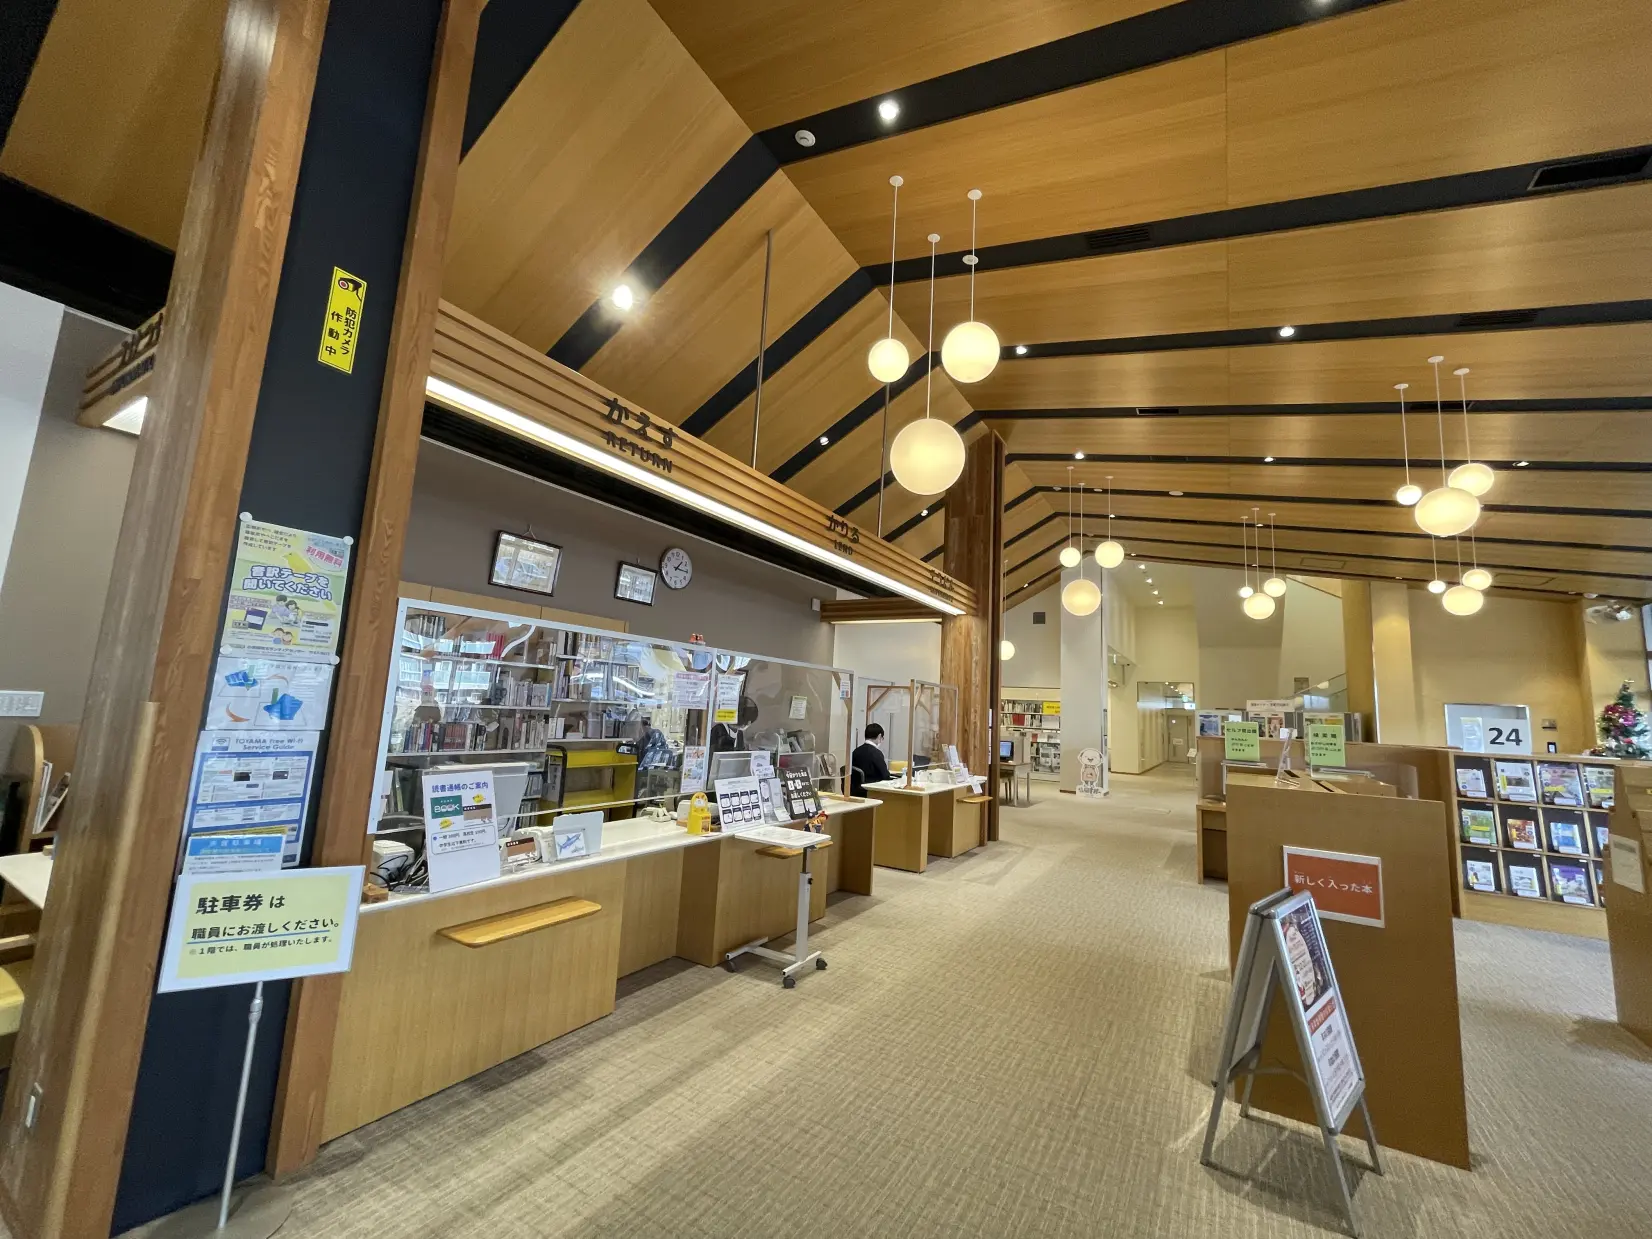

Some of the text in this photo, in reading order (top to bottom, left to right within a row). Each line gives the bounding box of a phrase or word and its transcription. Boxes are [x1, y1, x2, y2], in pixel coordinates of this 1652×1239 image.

[325, 310, 343, 356] 作動中
[340, 306, 357, 355] 防犯カメラ
[605, 397, 676, 449] かえす
[604, 430, 673, 474] RETURN
[827, 515, 860, 544] かりる
[306, 545, 343, 568] 利用無料
[833, 539, 853, 556] LEND
[251, 565, 330, 588] 音訳テープを
[243, 577, 332, 601] 聞いてください
[1488, 727, 1522, 746] 24
[432, 782, 488, 792] 読書通帳のご案内
[1293, 873, 1373, 894] 新しく入った本
[196, 893, 286, 915] 駐車券 は
[191, 917, 340, 940] 職員にお渡しください。
